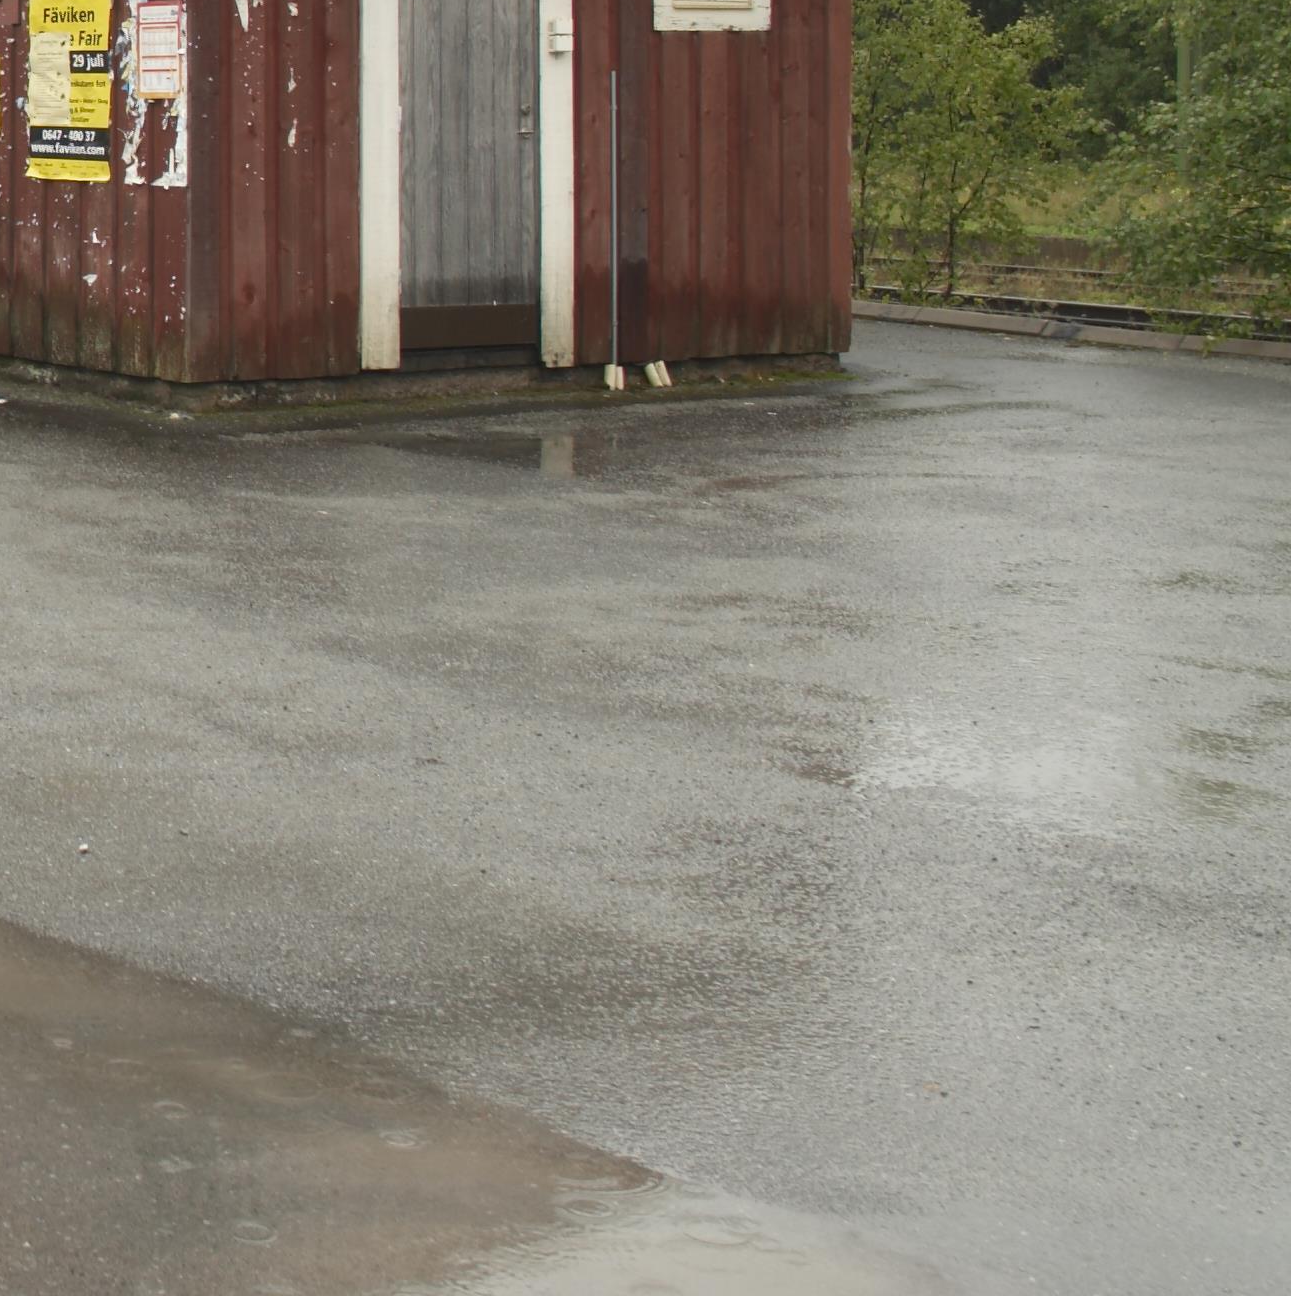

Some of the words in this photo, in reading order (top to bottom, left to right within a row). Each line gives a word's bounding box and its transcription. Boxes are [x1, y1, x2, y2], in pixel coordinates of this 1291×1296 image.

[43, 6, 95, 23] Fäviken
[79, 29, 103, 46] Fair
[72, 54, 84, 67] 29
[86, 54, 104, 71] juli
